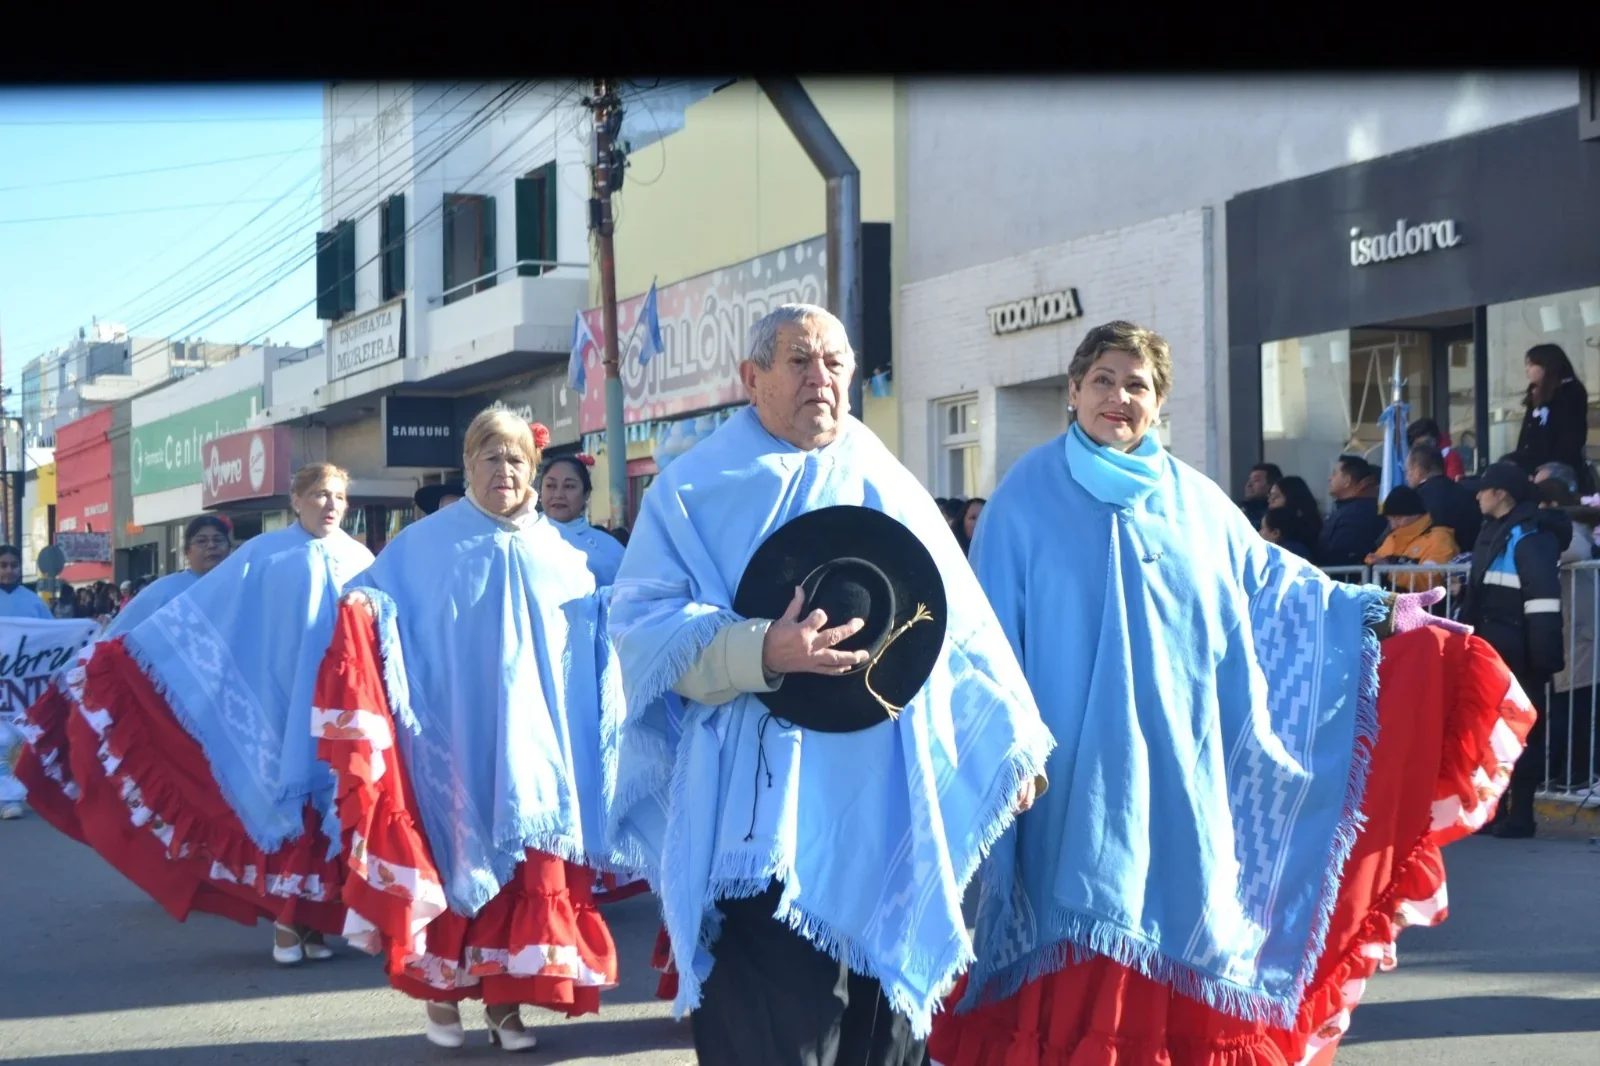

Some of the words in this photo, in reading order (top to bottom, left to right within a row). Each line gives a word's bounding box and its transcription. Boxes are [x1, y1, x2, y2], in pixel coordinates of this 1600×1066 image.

[1350, 218, 1462, 266] isadora
[987, 288, 1079, 335] TODOMODA
[337, 334, 396, 373] MOREIRA
[392, 425, 450, 437] SAMSUNG
